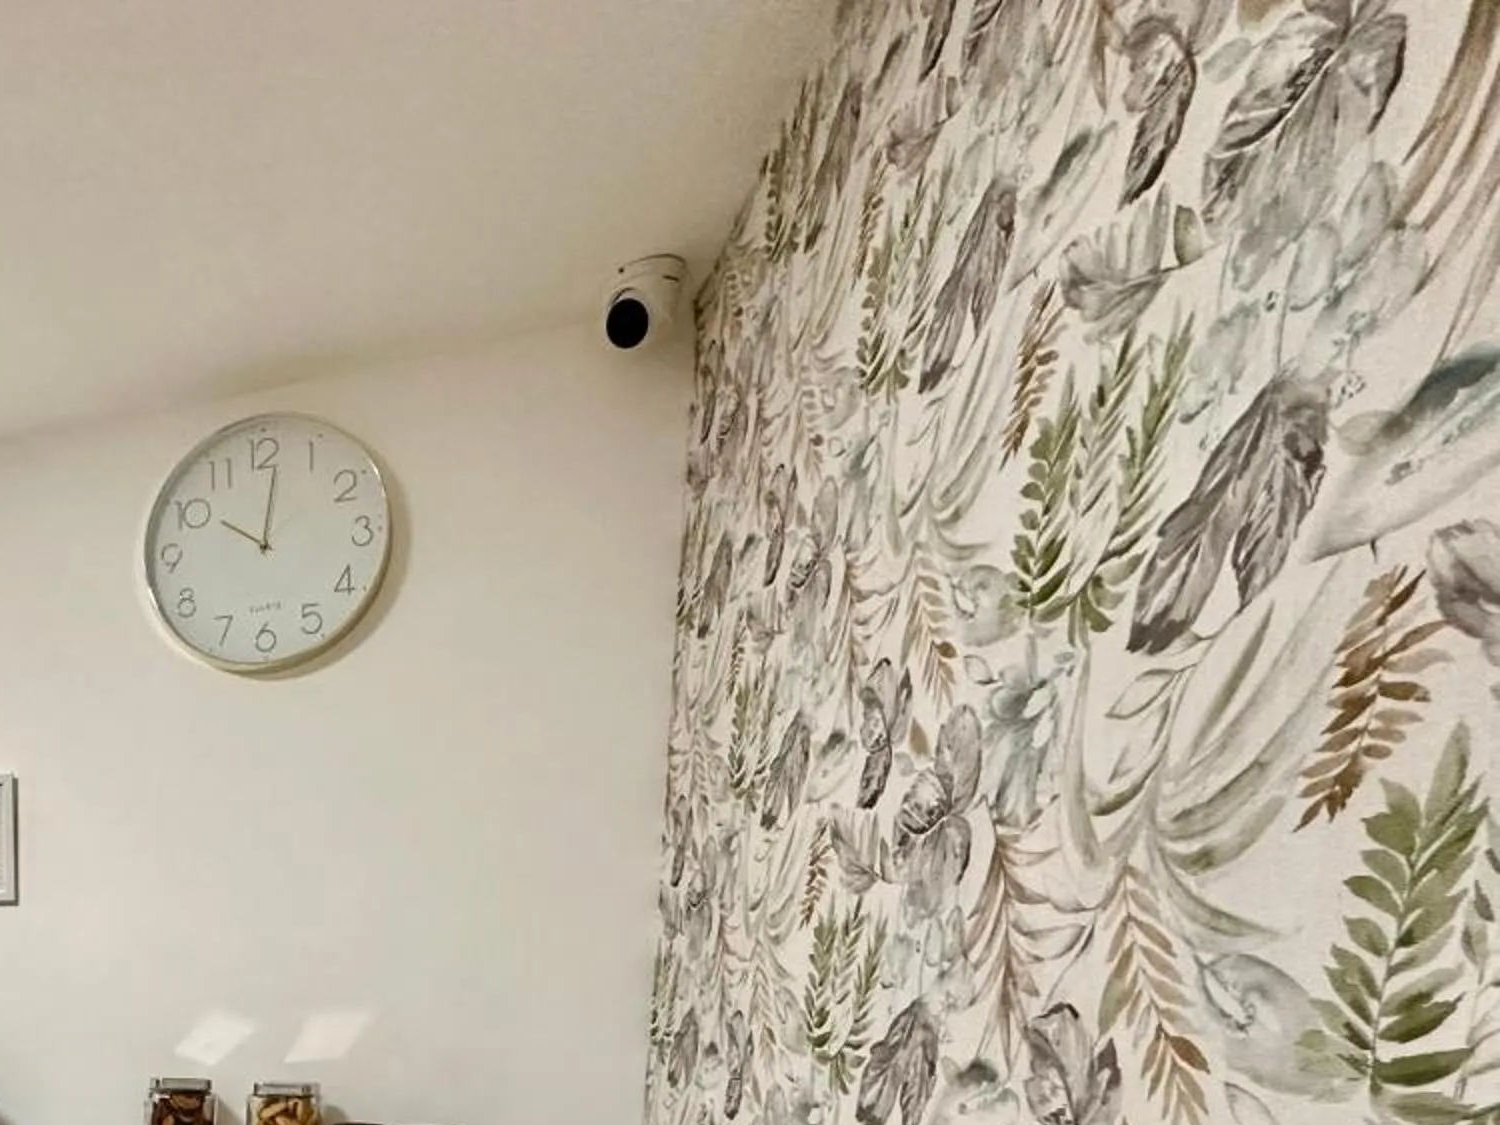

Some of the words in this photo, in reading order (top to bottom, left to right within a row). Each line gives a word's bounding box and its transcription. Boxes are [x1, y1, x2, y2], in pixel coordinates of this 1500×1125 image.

[250, 437, 279, 470] 12
[308, 440, 314, 471] 1
[209, 457, 232, 491] 11
[333, 469, 358, 503] 2
[174, 498, 211, 531] 10
[351, 515, 374, 546] 3
[161, 543, 183, 573] 9
[334, 564, 355, 595] 4
[177, 588, 197, 618] 8
[300, 603, 323, 634] 5
[214, 615, 233, 646] 7
[255, 623, 277, 652] 6
